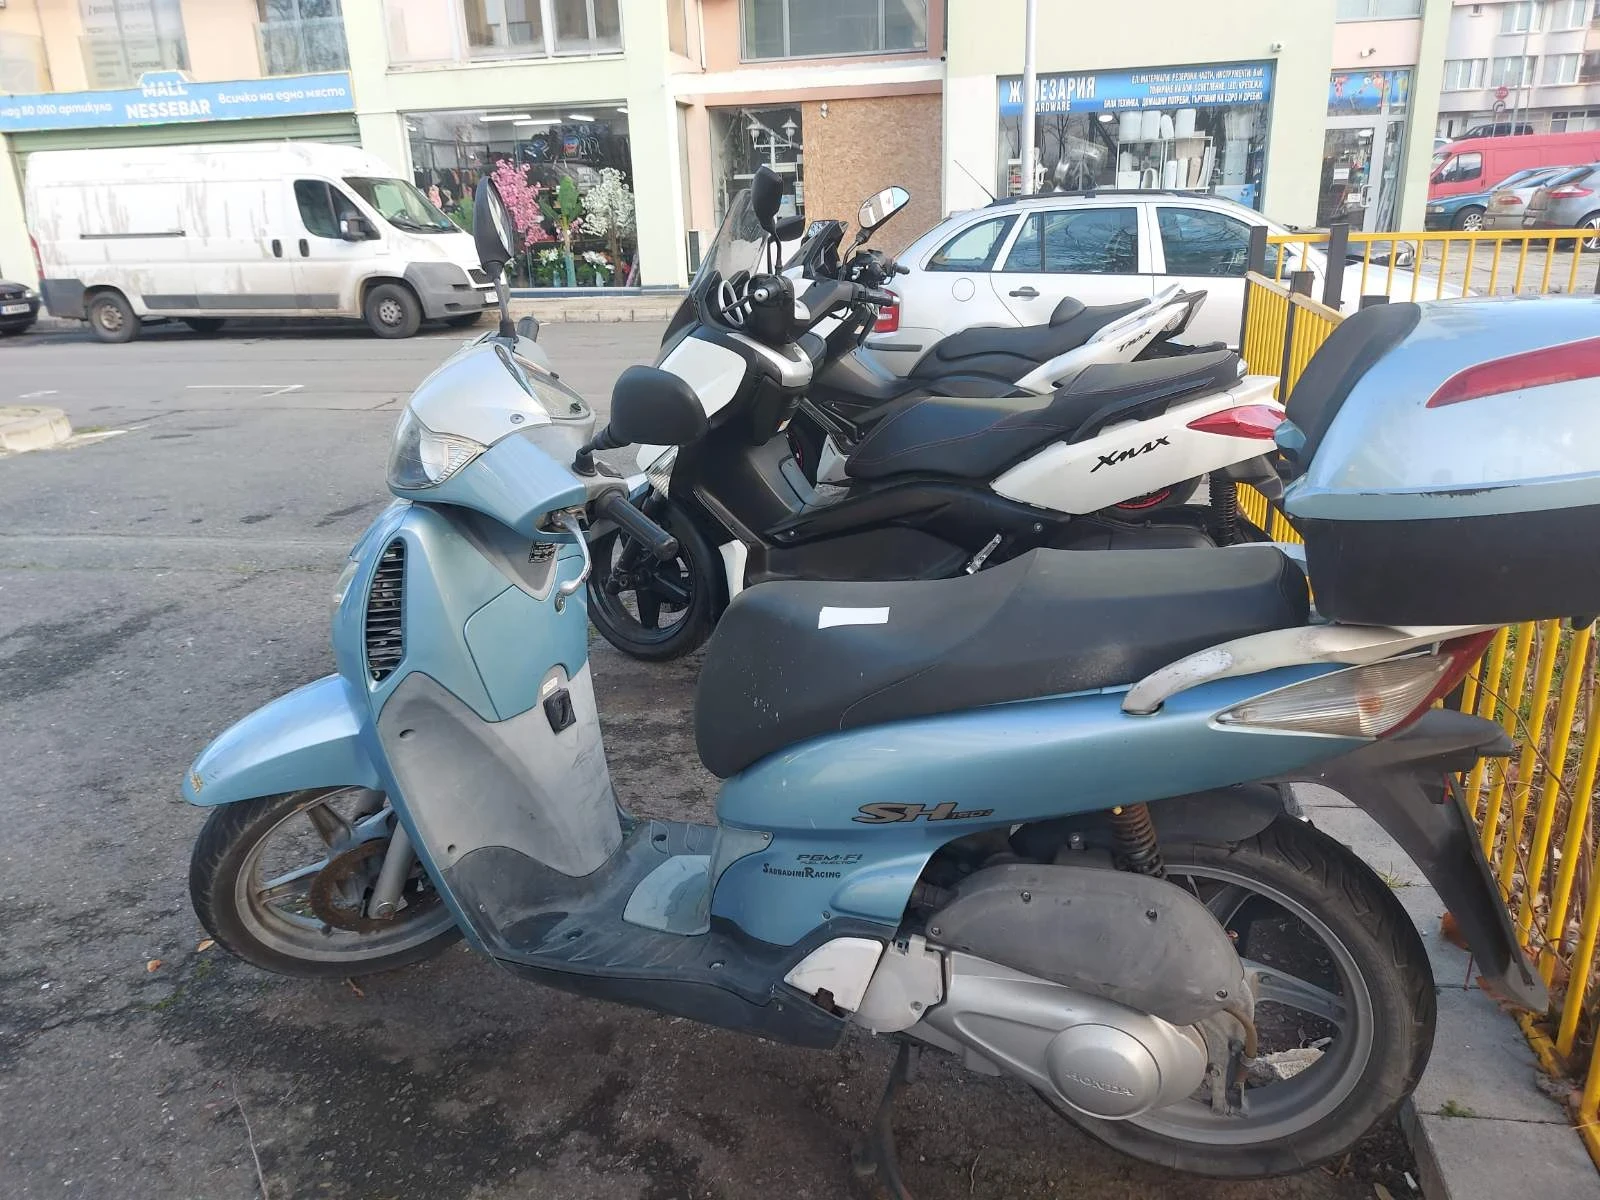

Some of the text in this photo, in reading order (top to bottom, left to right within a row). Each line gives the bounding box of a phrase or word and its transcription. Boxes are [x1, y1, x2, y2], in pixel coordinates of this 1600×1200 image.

[142, 81, 188, 98] MALL
[260, 92, 274, 102] на
[276, 90, 304, 103] едно
[305, 87, 346, 98] място
[36, 104, 57, 115] 000
[58, 102, 113, 117] артикула
[125, 99, 212, 119] NESSEBAR
[1035, 101, 1071, 113] ARDWARE
[1064, 1070, 1135, 1096] HONDA
